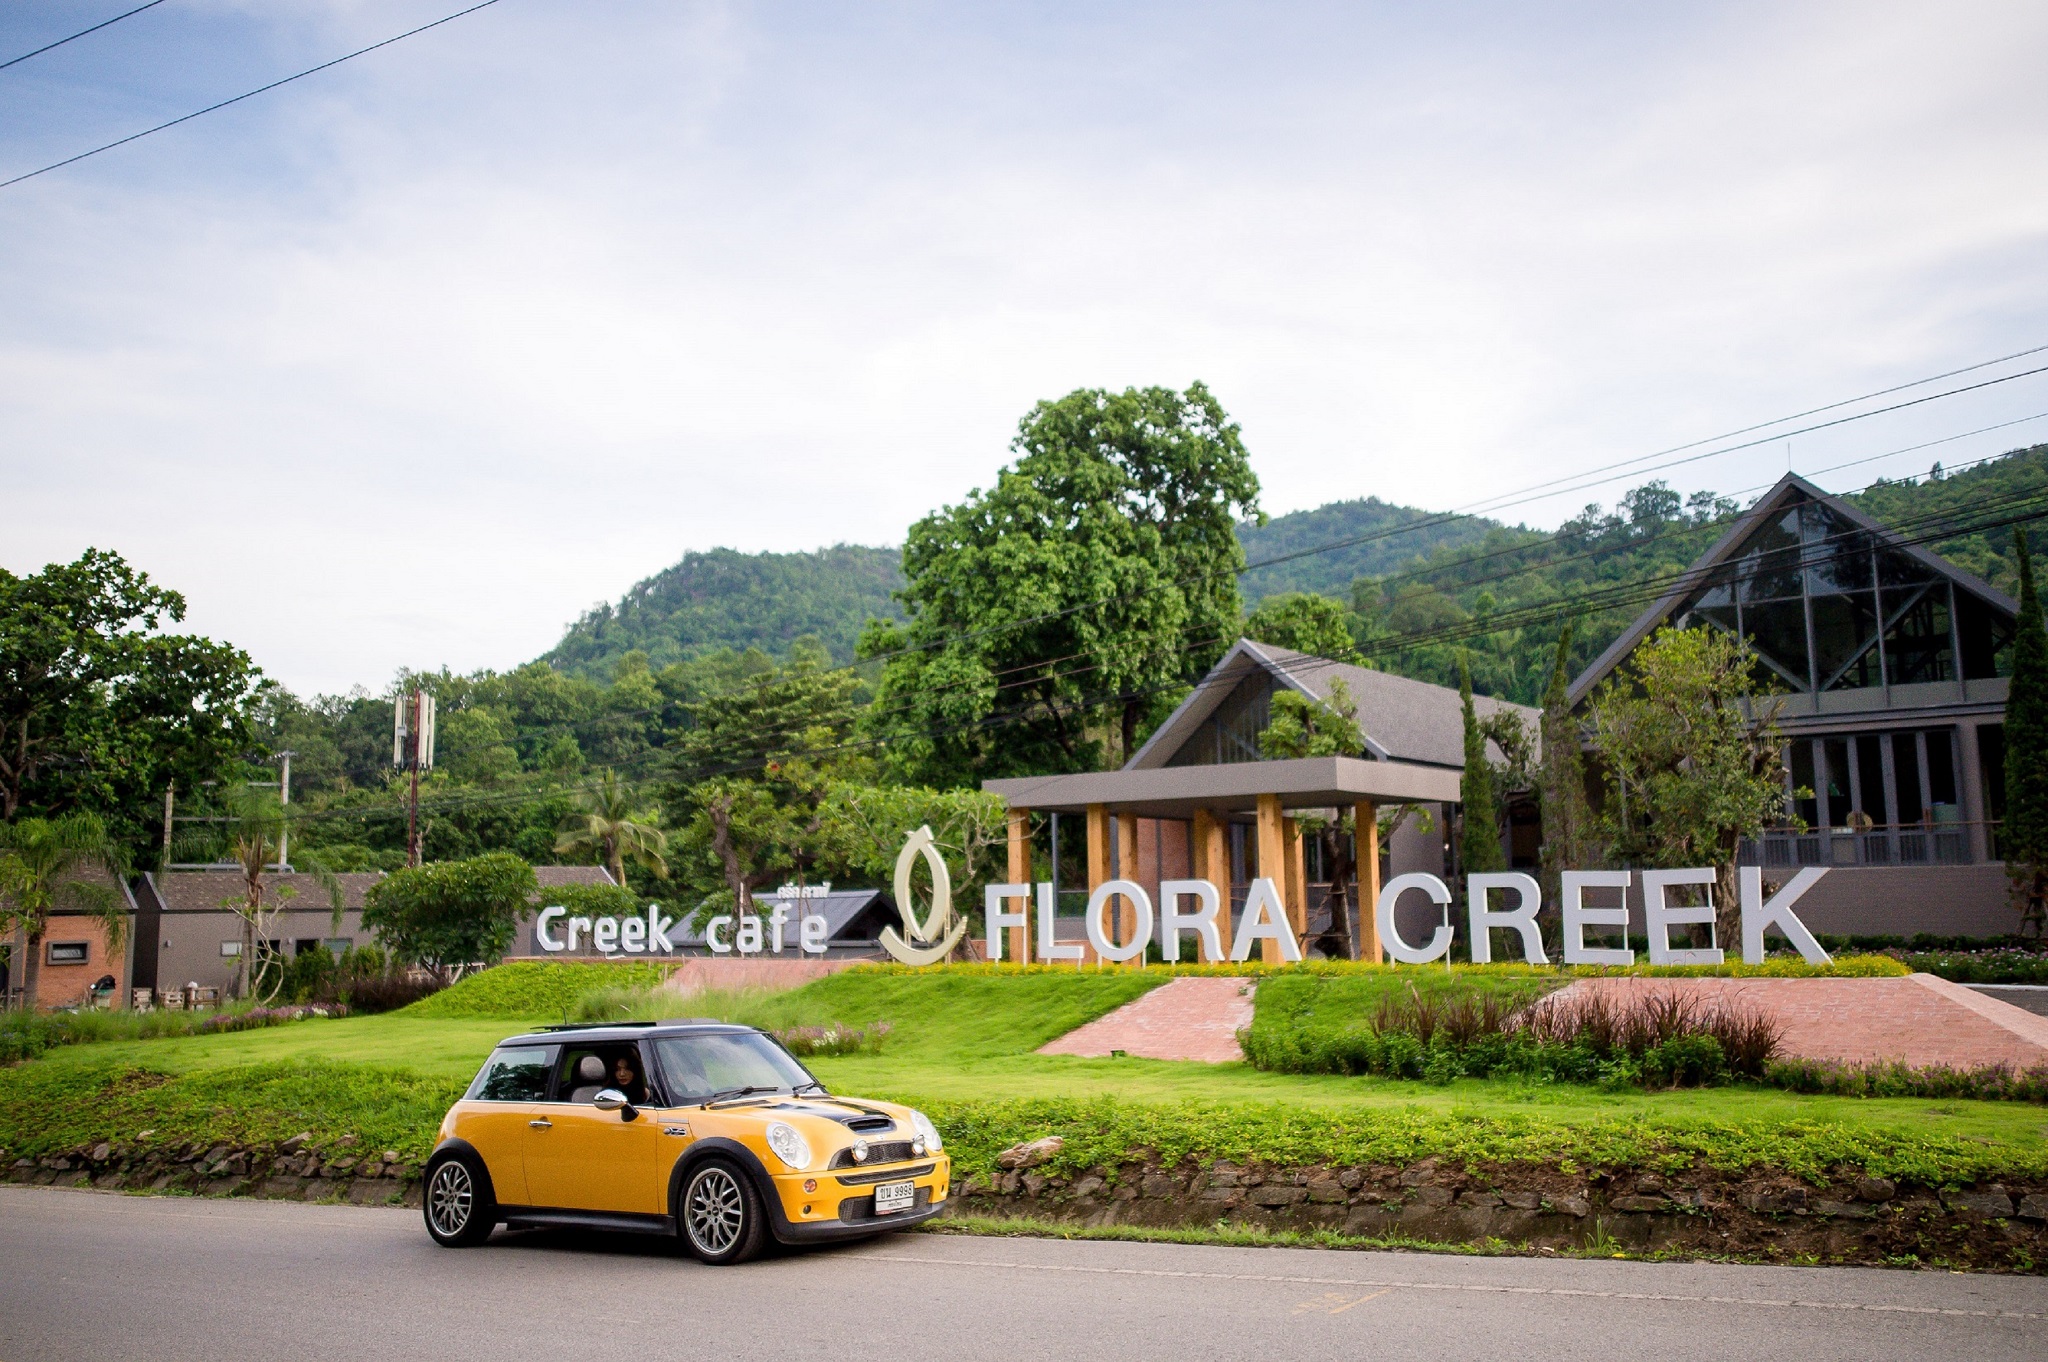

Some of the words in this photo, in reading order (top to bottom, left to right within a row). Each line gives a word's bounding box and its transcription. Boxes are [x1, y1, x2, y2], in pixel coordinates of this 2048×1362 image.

[537, 905, 673, 952] Creek
[706, 902, 828, 953] cafe
[985, 877, 1302, 961] FLORA
[1376, 866, 1834, 965] CREEK
